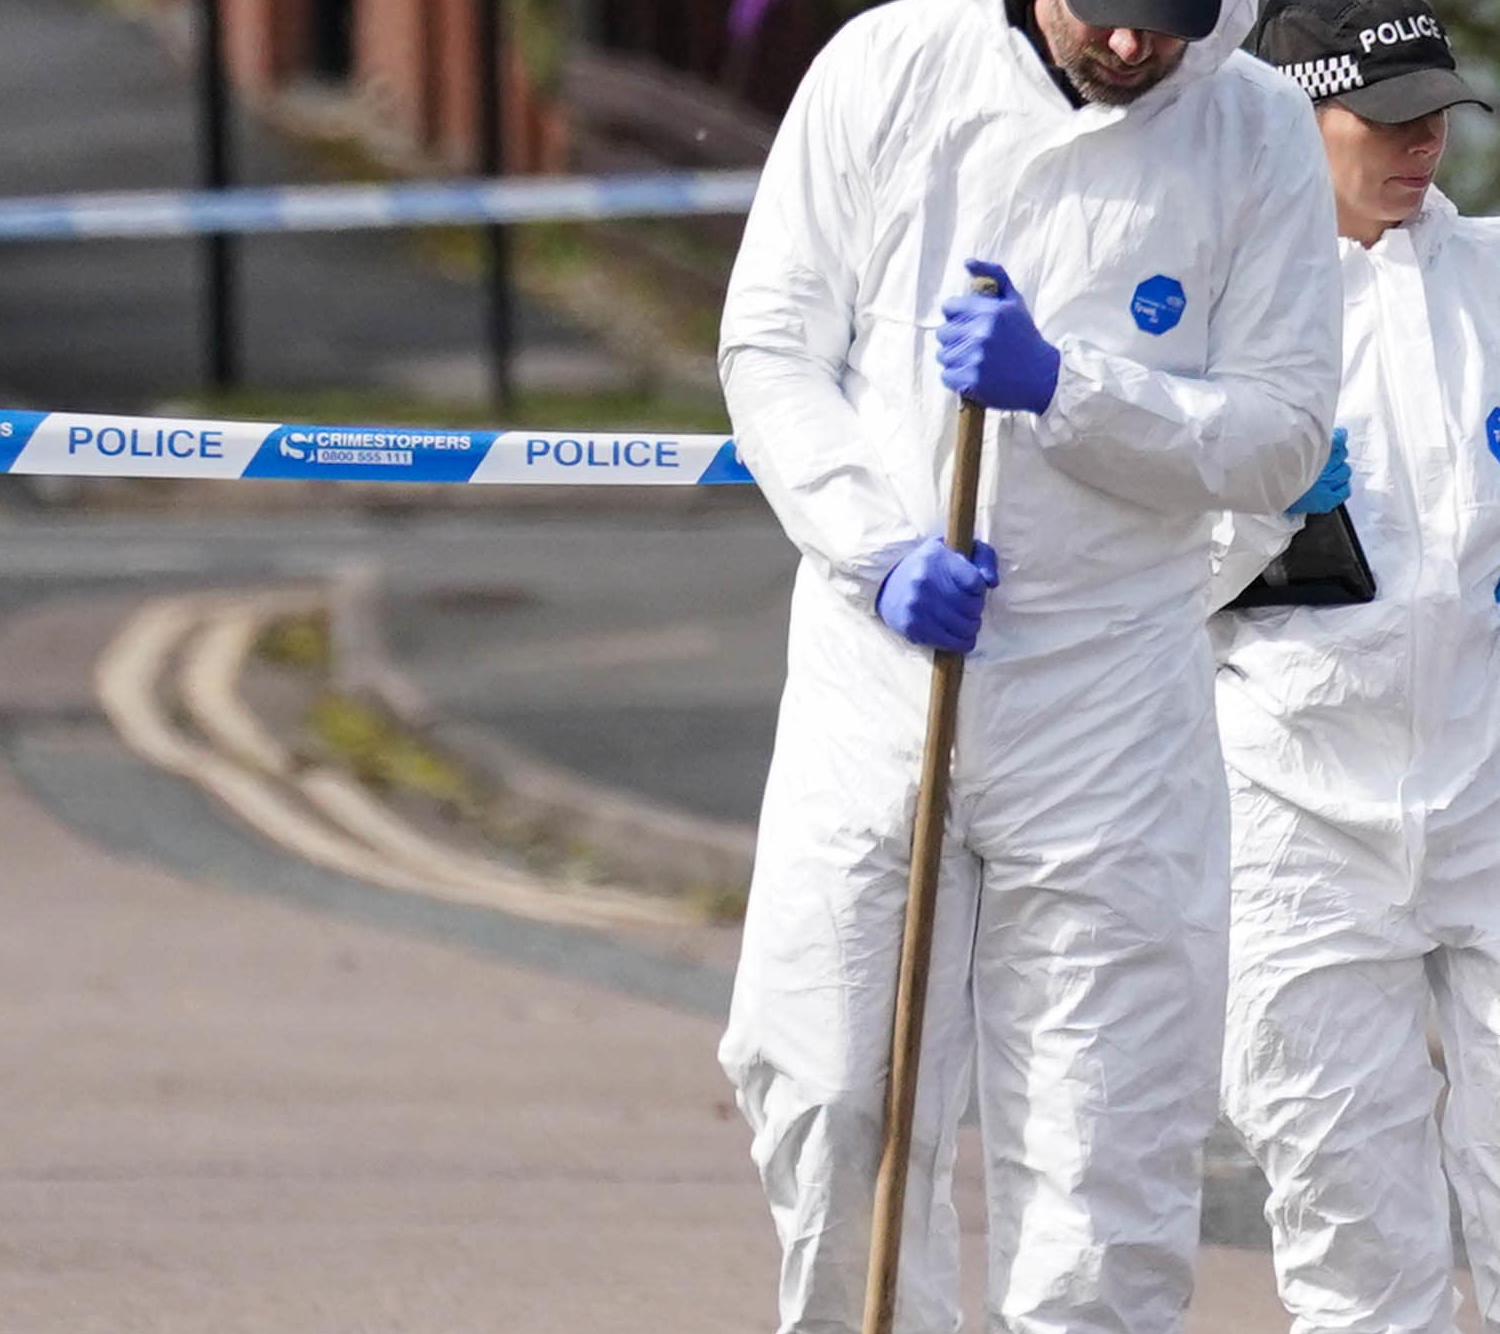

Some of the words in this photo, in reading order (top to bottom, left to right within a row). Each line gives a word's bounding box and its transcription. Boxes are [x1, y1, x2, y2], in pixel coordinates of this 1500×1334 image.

[1359, 14, 1441, 54] POLICE
[67, 426, 224, 459] POLICE
[316, 431, 472, 450] CRIMESTOPPERS
[525, 438, 680, 468] POLICE
[321, 450, 354, 463] 0800
[356, 451, 383, 464] 555
[386, 452, 409, 465] 111
